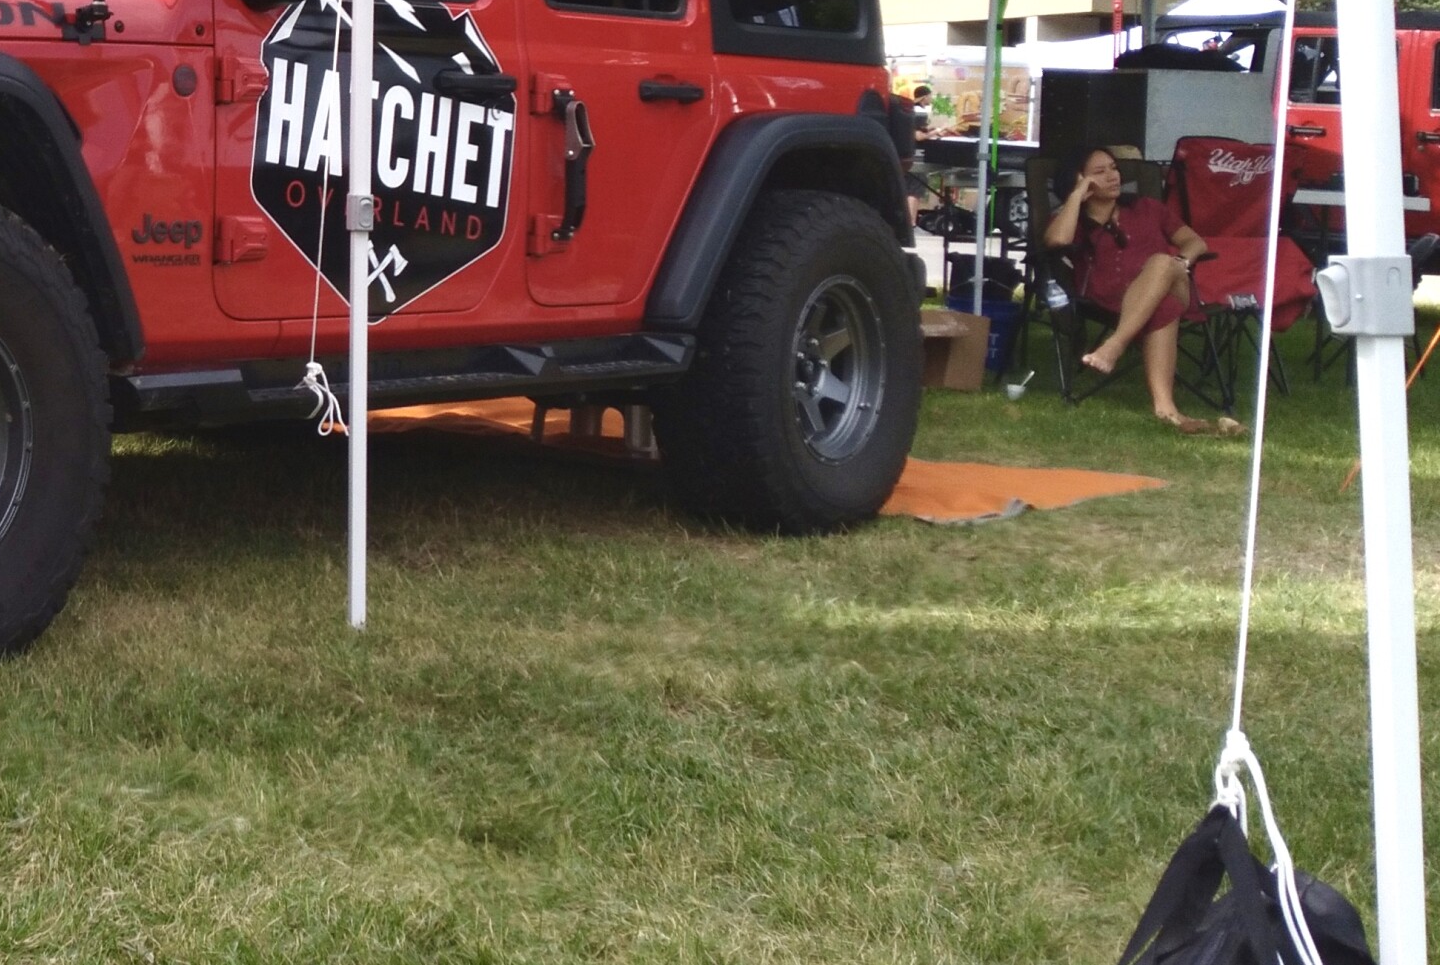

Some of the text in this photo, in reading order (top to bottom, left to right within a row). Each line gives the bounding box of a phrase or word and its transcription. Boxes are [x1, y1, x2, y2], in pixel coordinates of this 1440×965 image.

[265, 58, 514, 208] HACHET
[132, 213, 203, 250] Jeep
[285, 180, 484, 241] OVRLAND
